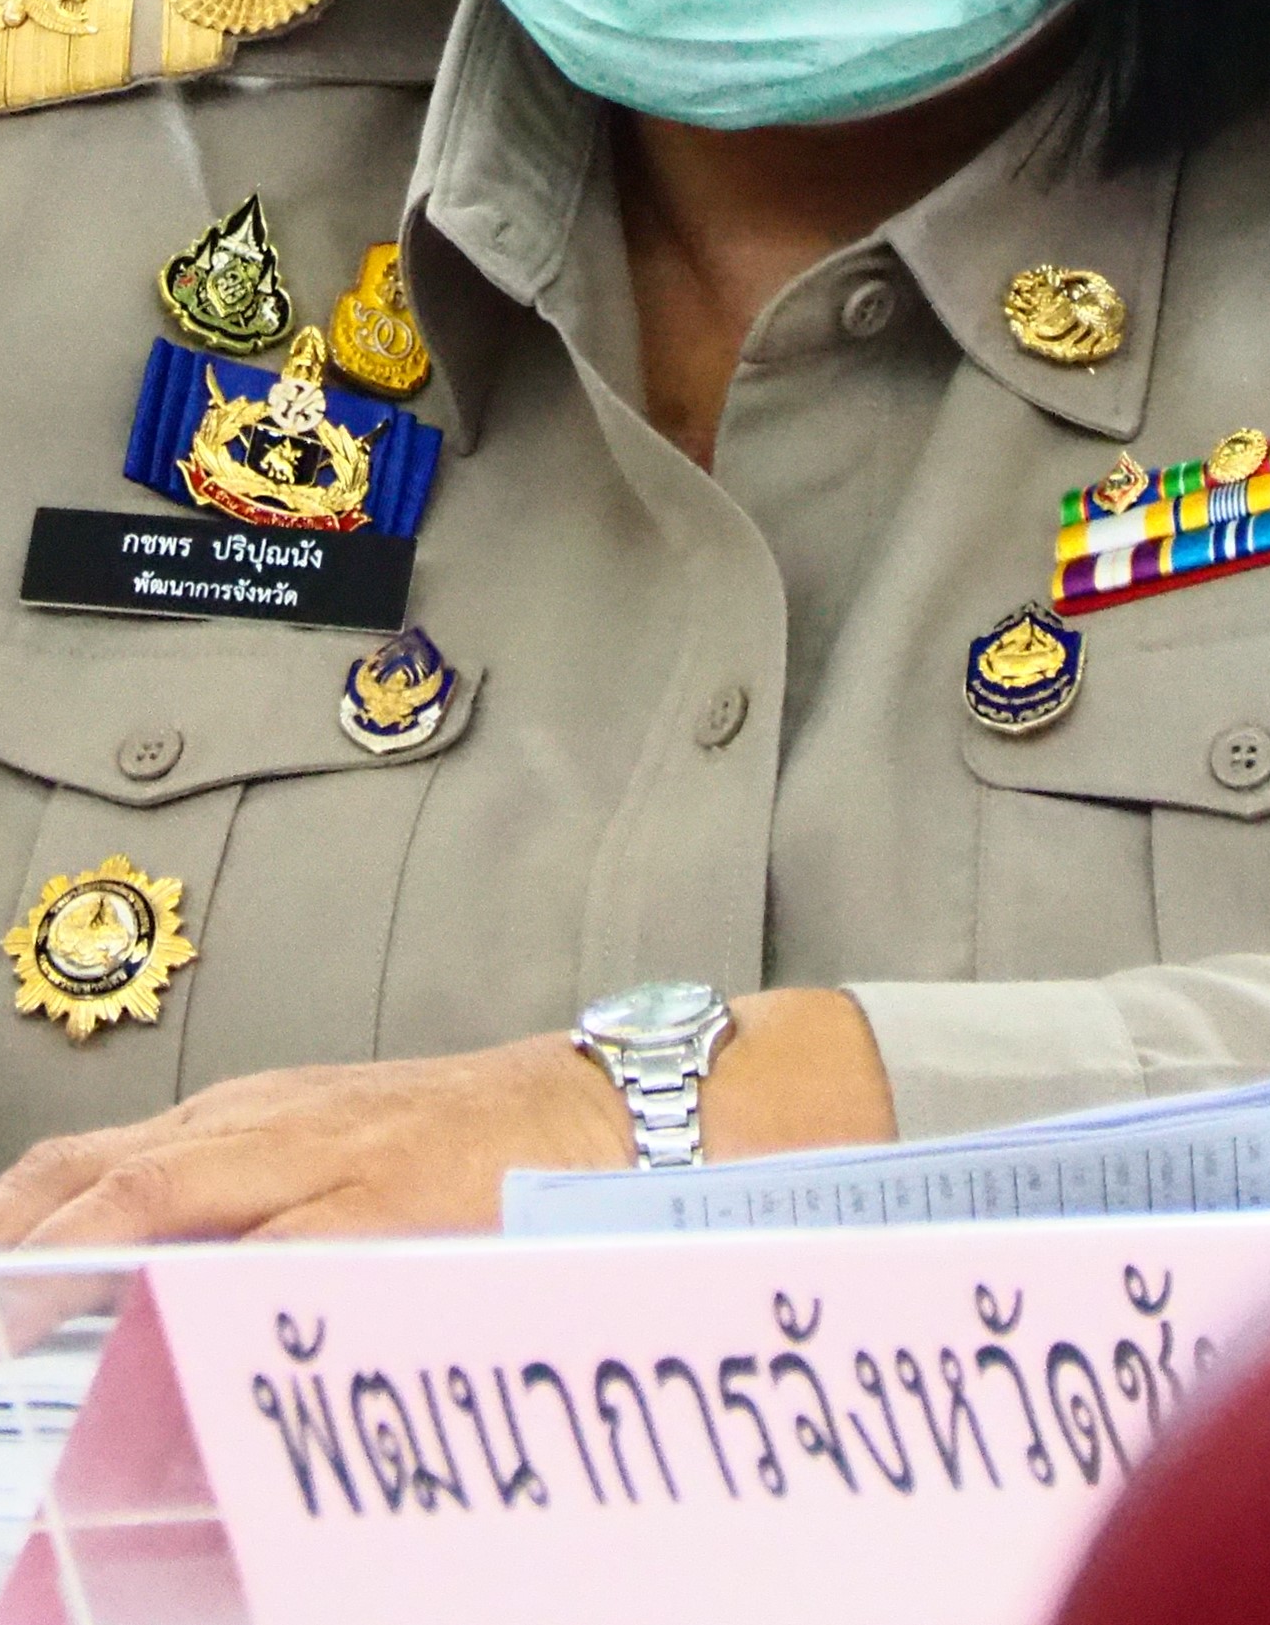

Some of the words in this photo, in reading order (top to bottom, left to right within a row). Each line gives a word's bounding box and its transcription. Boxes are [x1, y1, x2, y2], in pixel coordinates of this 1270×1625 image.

[121, 532, 193, 557] กชพร
[212, 533, 324, 573] ปริปุณนัง
[133, 570, 299, 607] พัฒนาการจังหวัด
[251, 1262, 1217, 1518] พัฒนาการจังหวัดชั
